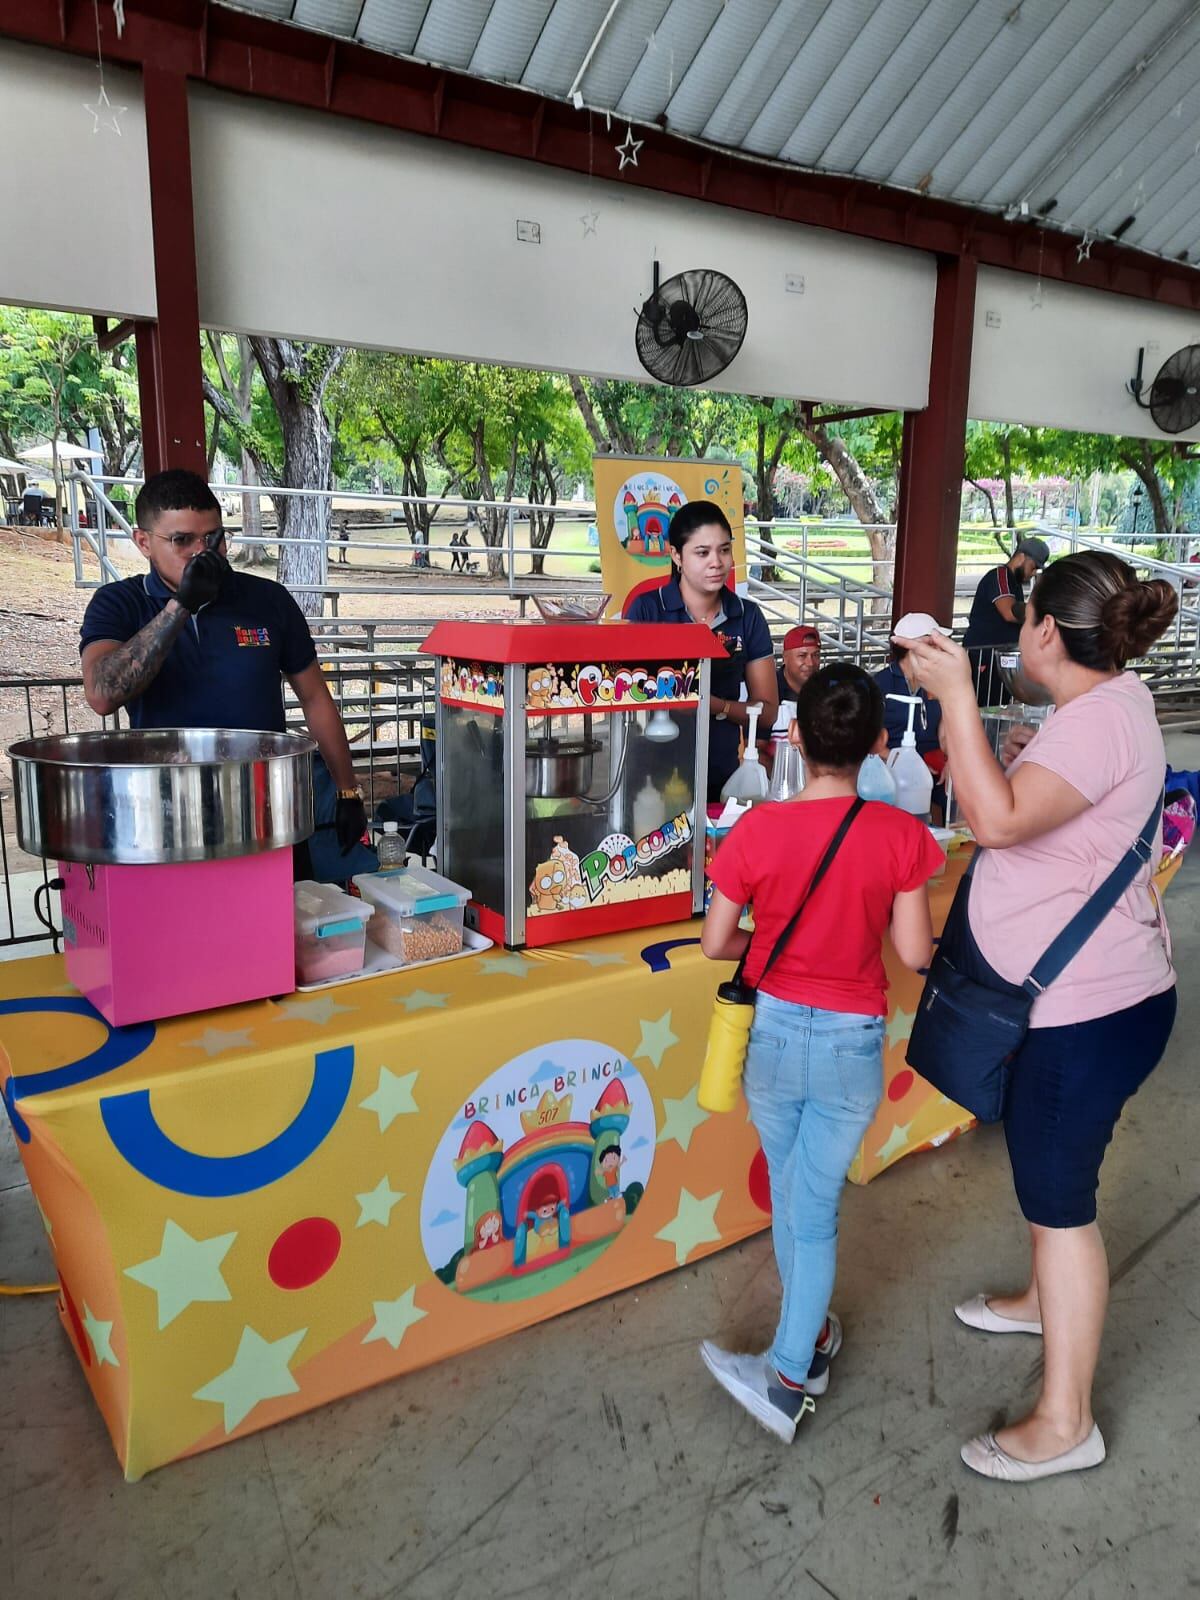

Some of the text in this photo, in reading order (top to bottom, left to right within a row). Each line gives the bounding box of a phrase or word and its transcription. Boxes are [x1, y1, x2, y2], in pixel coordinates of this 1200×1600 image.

[577, 663, 696, 706] POPCORN
[580, 811, 692, 902] POPCORN
[464, 1059, 623, 1119] BRINCA BRINCA
[537, 1107, 560, 1126] 507
